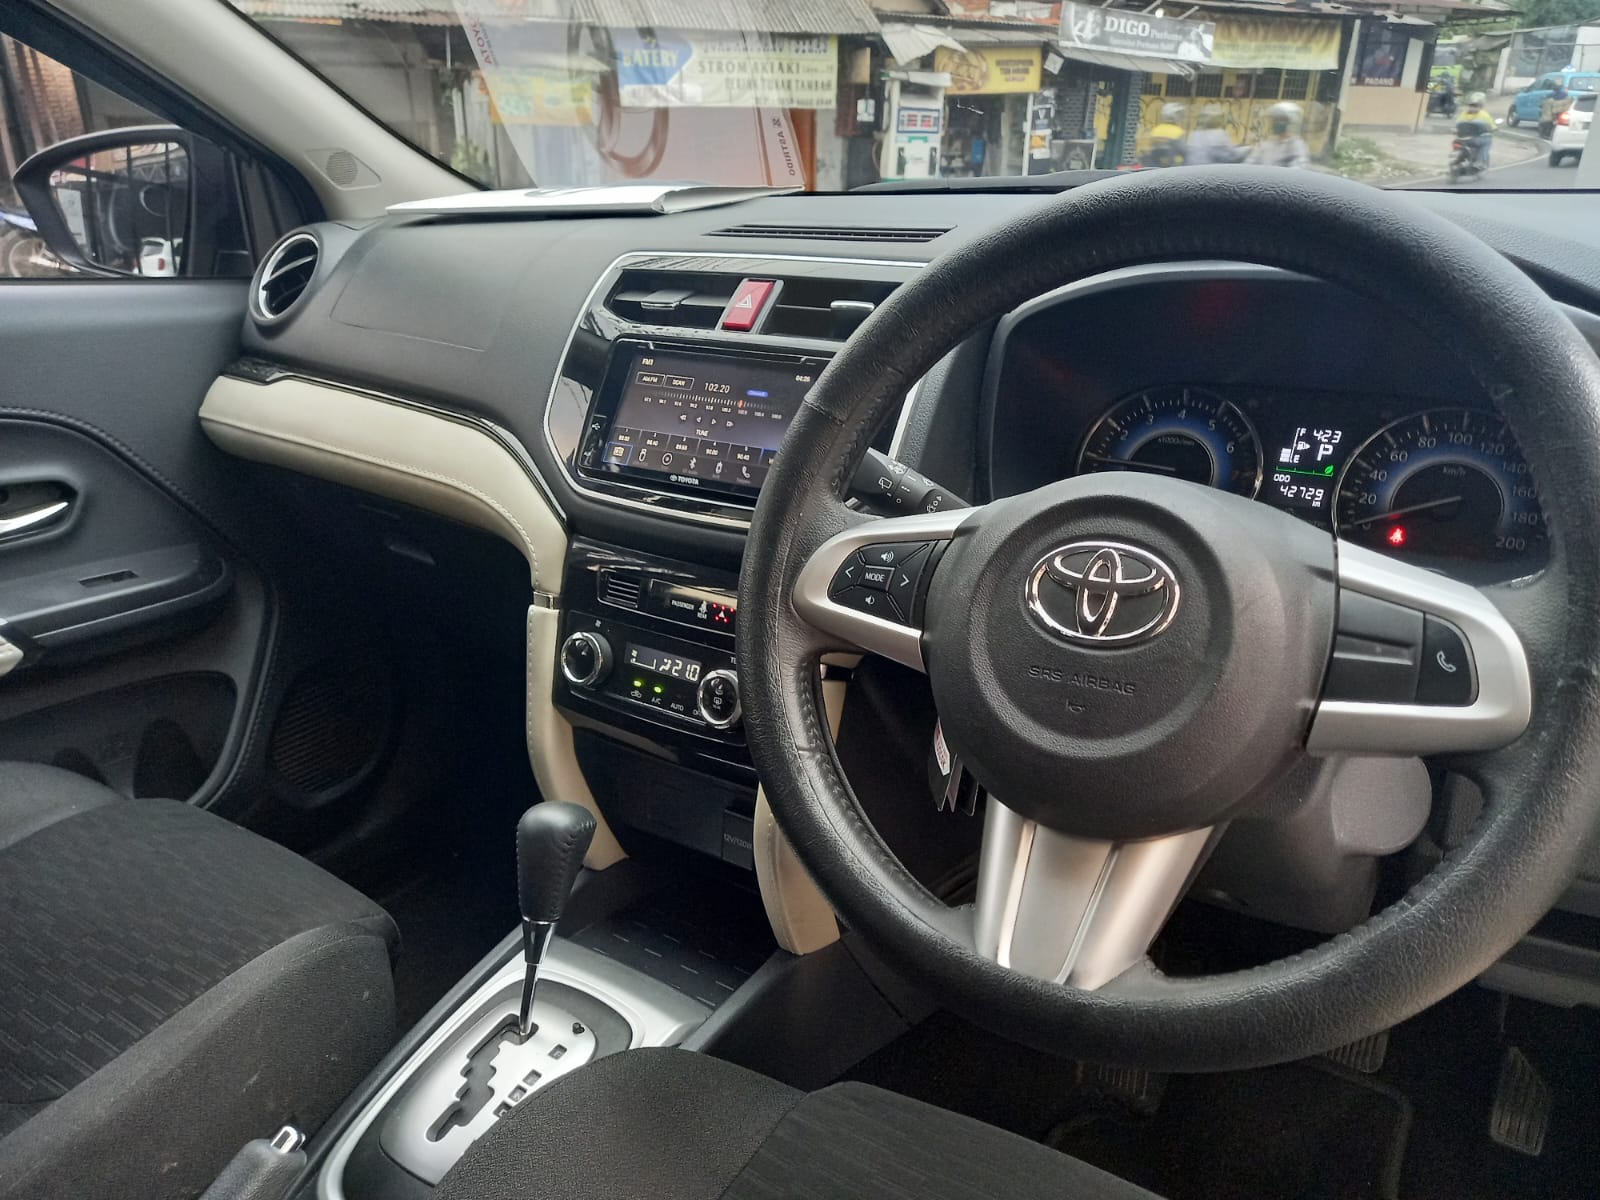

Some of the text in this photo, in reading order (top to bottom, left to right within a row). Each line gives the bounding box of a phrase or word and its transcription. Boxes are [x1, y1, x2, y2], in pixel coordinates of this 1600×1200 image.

[1104, 16, 1150, 37] DIGO
[698, 61, 747, 74] STROM
[704, 382, 730, 394] 102.20
[1146, 415, 1154, 426] 3
[1178, 409, 1186, 420] 4
[1208, 420, 1216, 431] 5
[1120, 430, 1129, 441] 2
[1300, 427, 1307, 437] F
[1418, 436, 1436, 449] 80
[1449, 432, 1473, 445] 100
[1226, 441, 1235, 454] 6
[1317, 443, 1333, 461] P
[1480, 442, 1505, 455] 120
[1293, 454, 1300, 463] E
[1390, 450, 1408, 462] 60
[678, 475, 699, 485] TOYOTA
[1273, 473, 1291, 483] ODO
[1369, 469, 1387, 482] 40
[1280, 485, 1324, 501] 42729
[1359, 492, 1377, 505] 20
[1496, 536, 1526, 551] 200
[865, 572, 886, 583] MODE
[1027, 664, 1136, 697] SRS AIRBAG
[651, 696, 662, 705] A/C
[670, 702, 684, 712] AUTO
